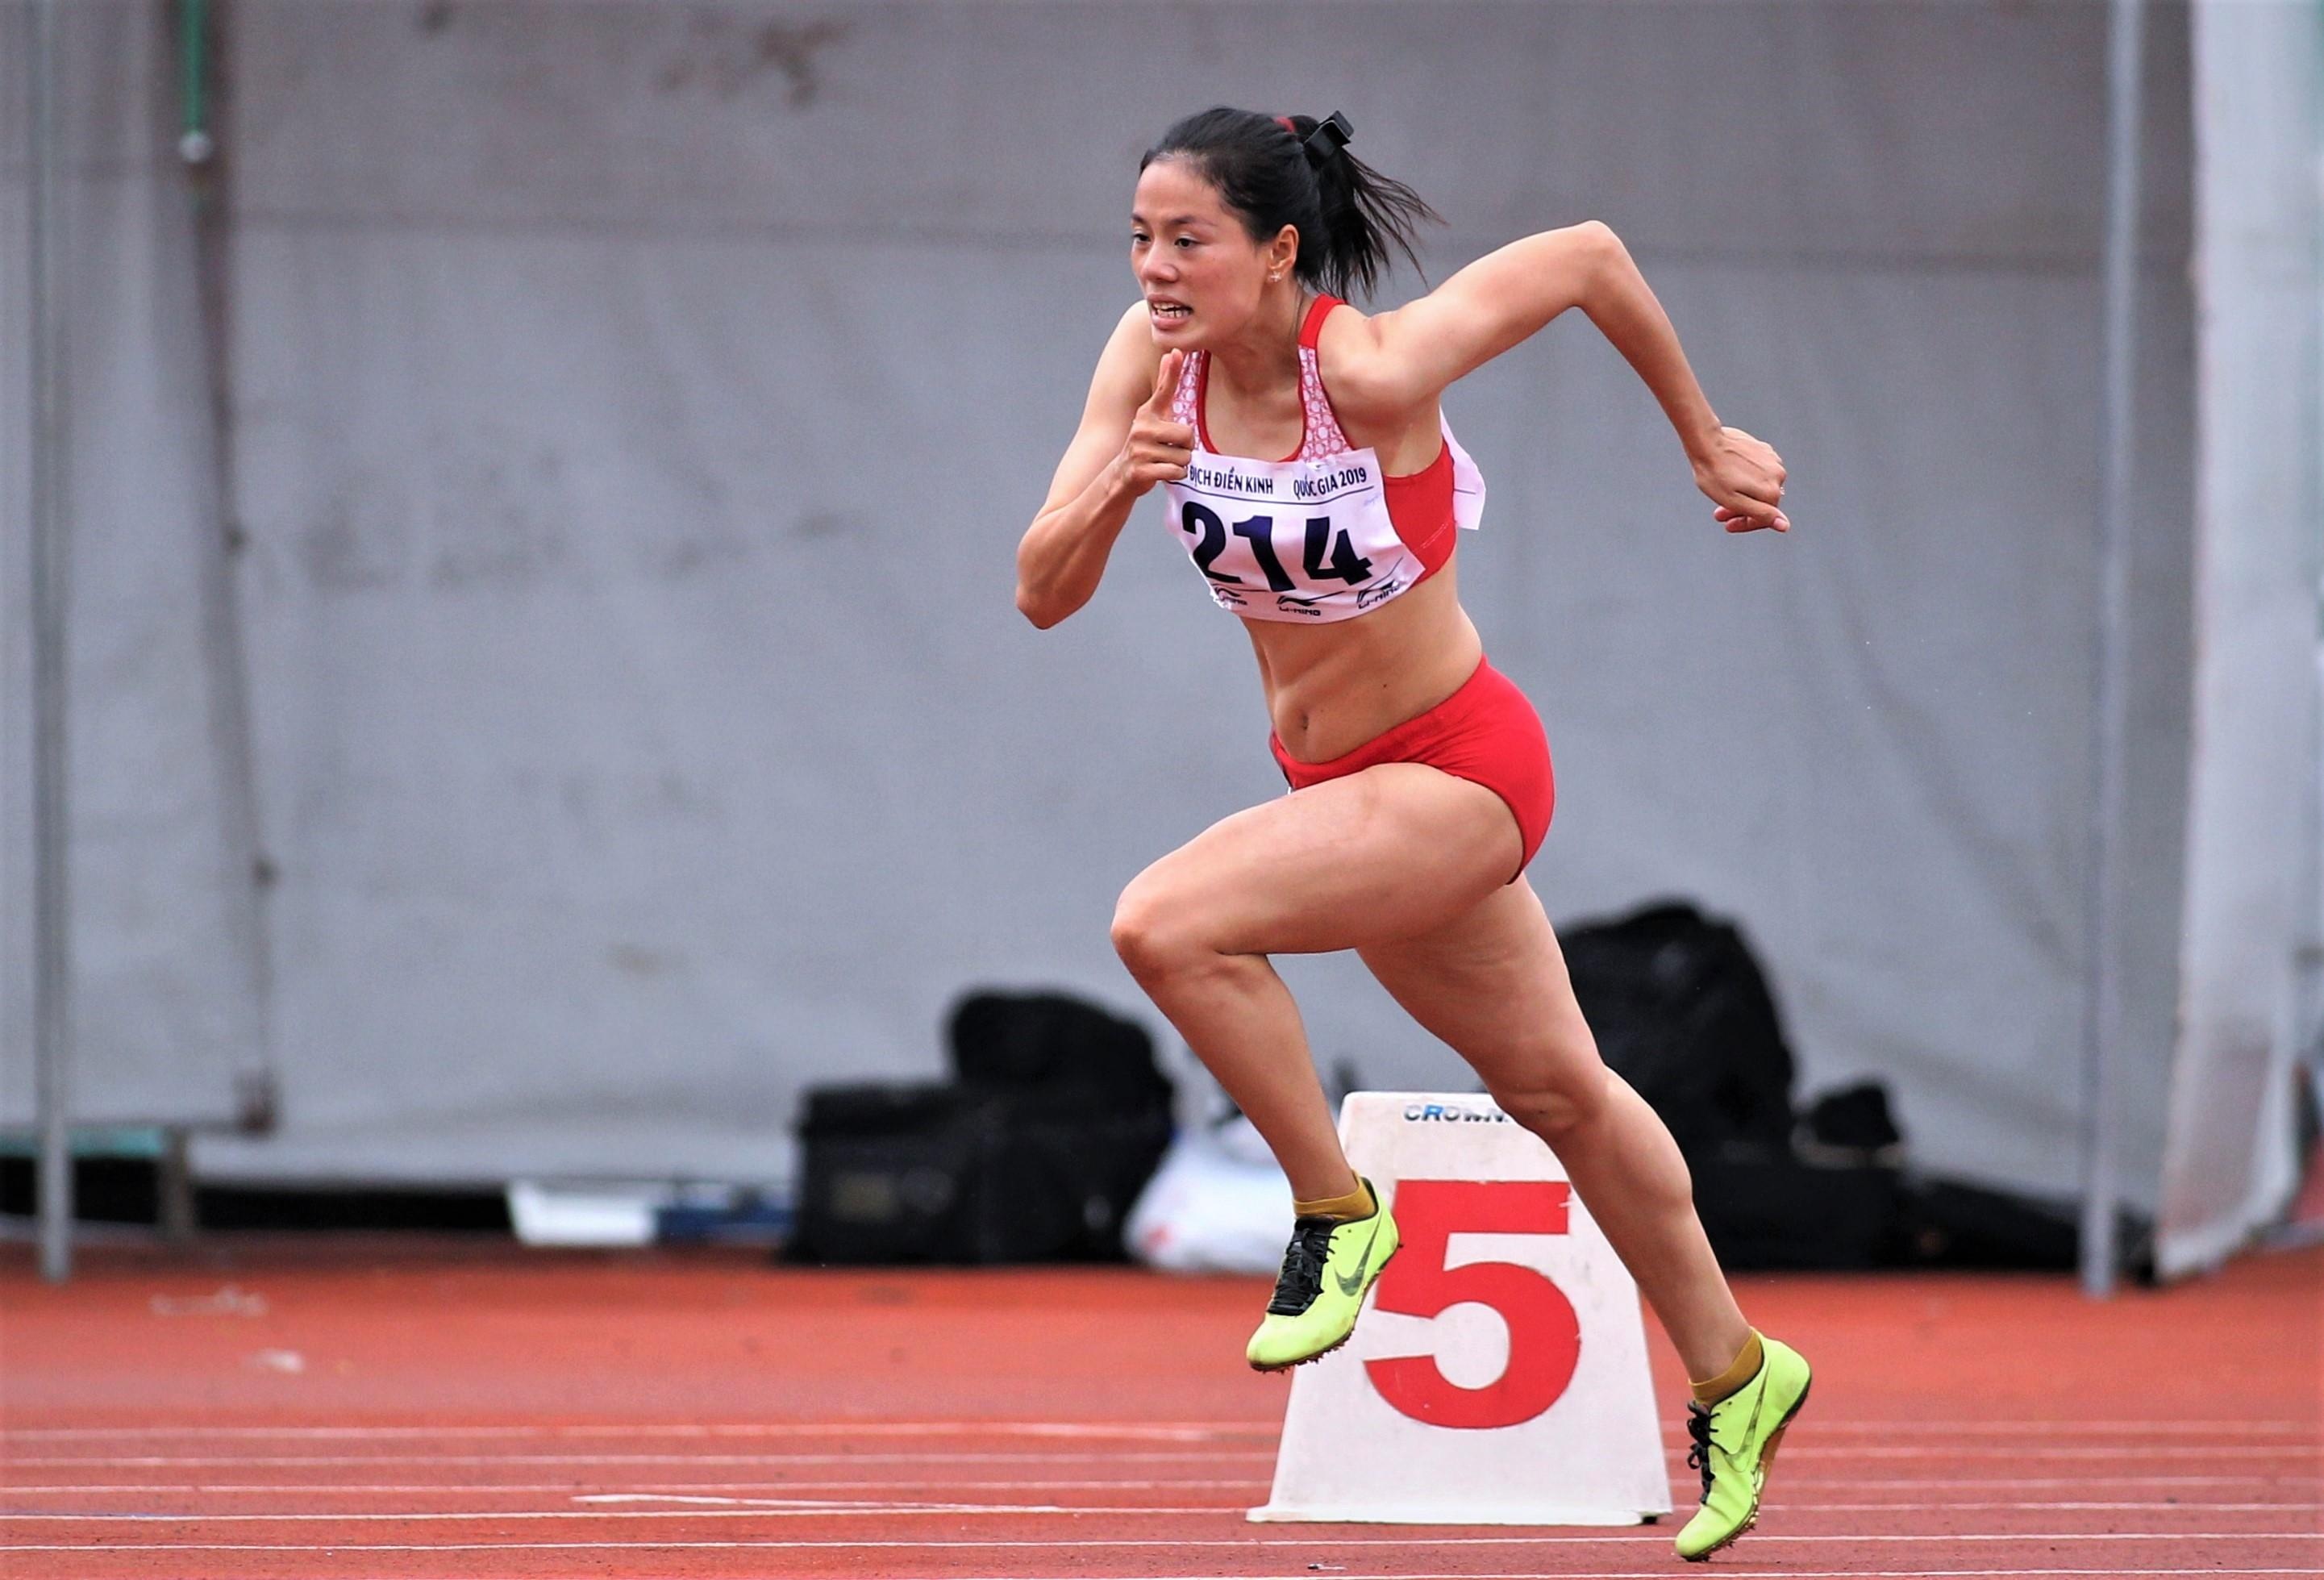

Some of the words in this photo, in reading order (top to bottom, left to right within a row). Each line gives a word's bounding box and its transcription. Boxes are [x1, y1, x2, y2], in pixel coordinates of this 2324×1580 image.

[1245, 476, 1273, 495] KINH
[1317, 474, 1339, 495] GIA
[1339, 467, 1367, 487] 2019
[1181, 501, 1373, 592] 214
[1363, 1179, 1581, 1429] 5
